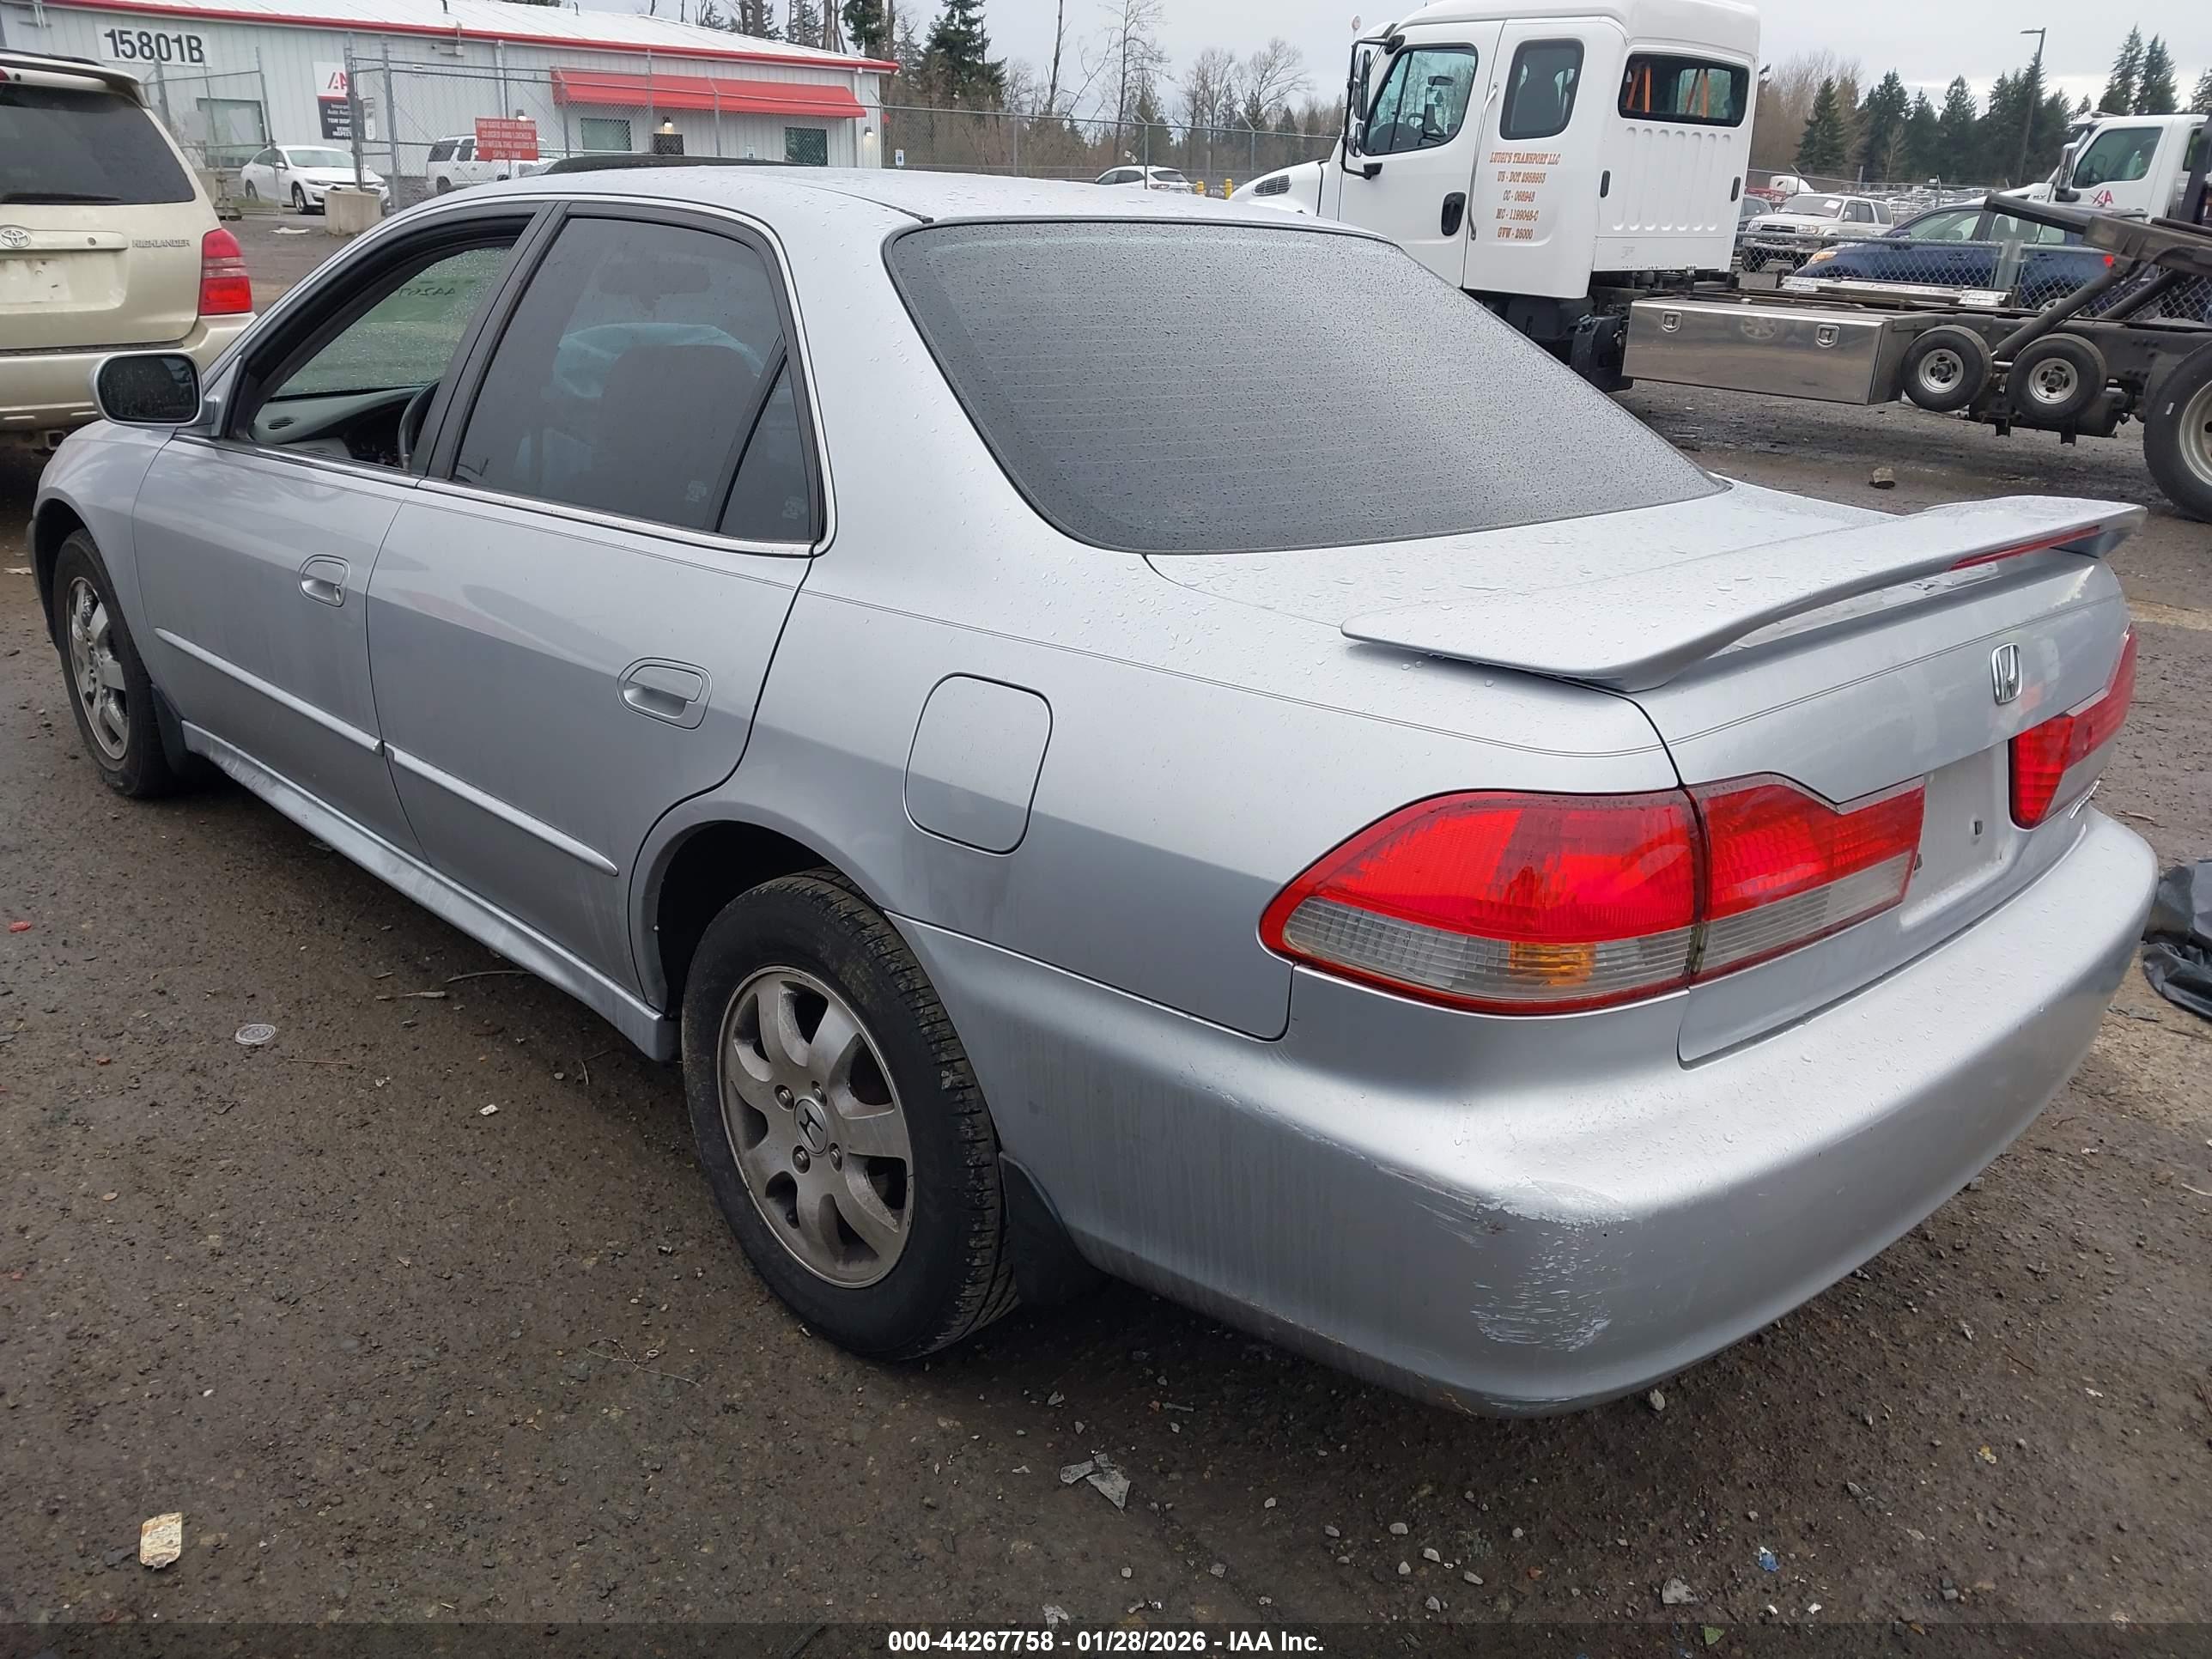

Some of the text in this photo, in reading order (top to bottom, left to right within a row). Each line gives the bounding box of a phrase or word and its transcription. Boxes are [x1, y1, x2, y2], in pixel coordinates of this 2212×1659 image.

[103, 28, 204, 63] 15801B
[1513, 152, 1548, 164] TRANSPORT
[1547, 154, 1561, 165] LLC
[1498, 171, 1506, 182] US
[1509, 172, 1522, 183] DOT
[1503, 190, 1511, 201] CC
[1496, 208, 1506, 220] MC
[1498, 227, 1512, 238] GVW
[1515, 228, 1534, 240] 26000
[132, 240, 191, 248] HIGHLANDER
